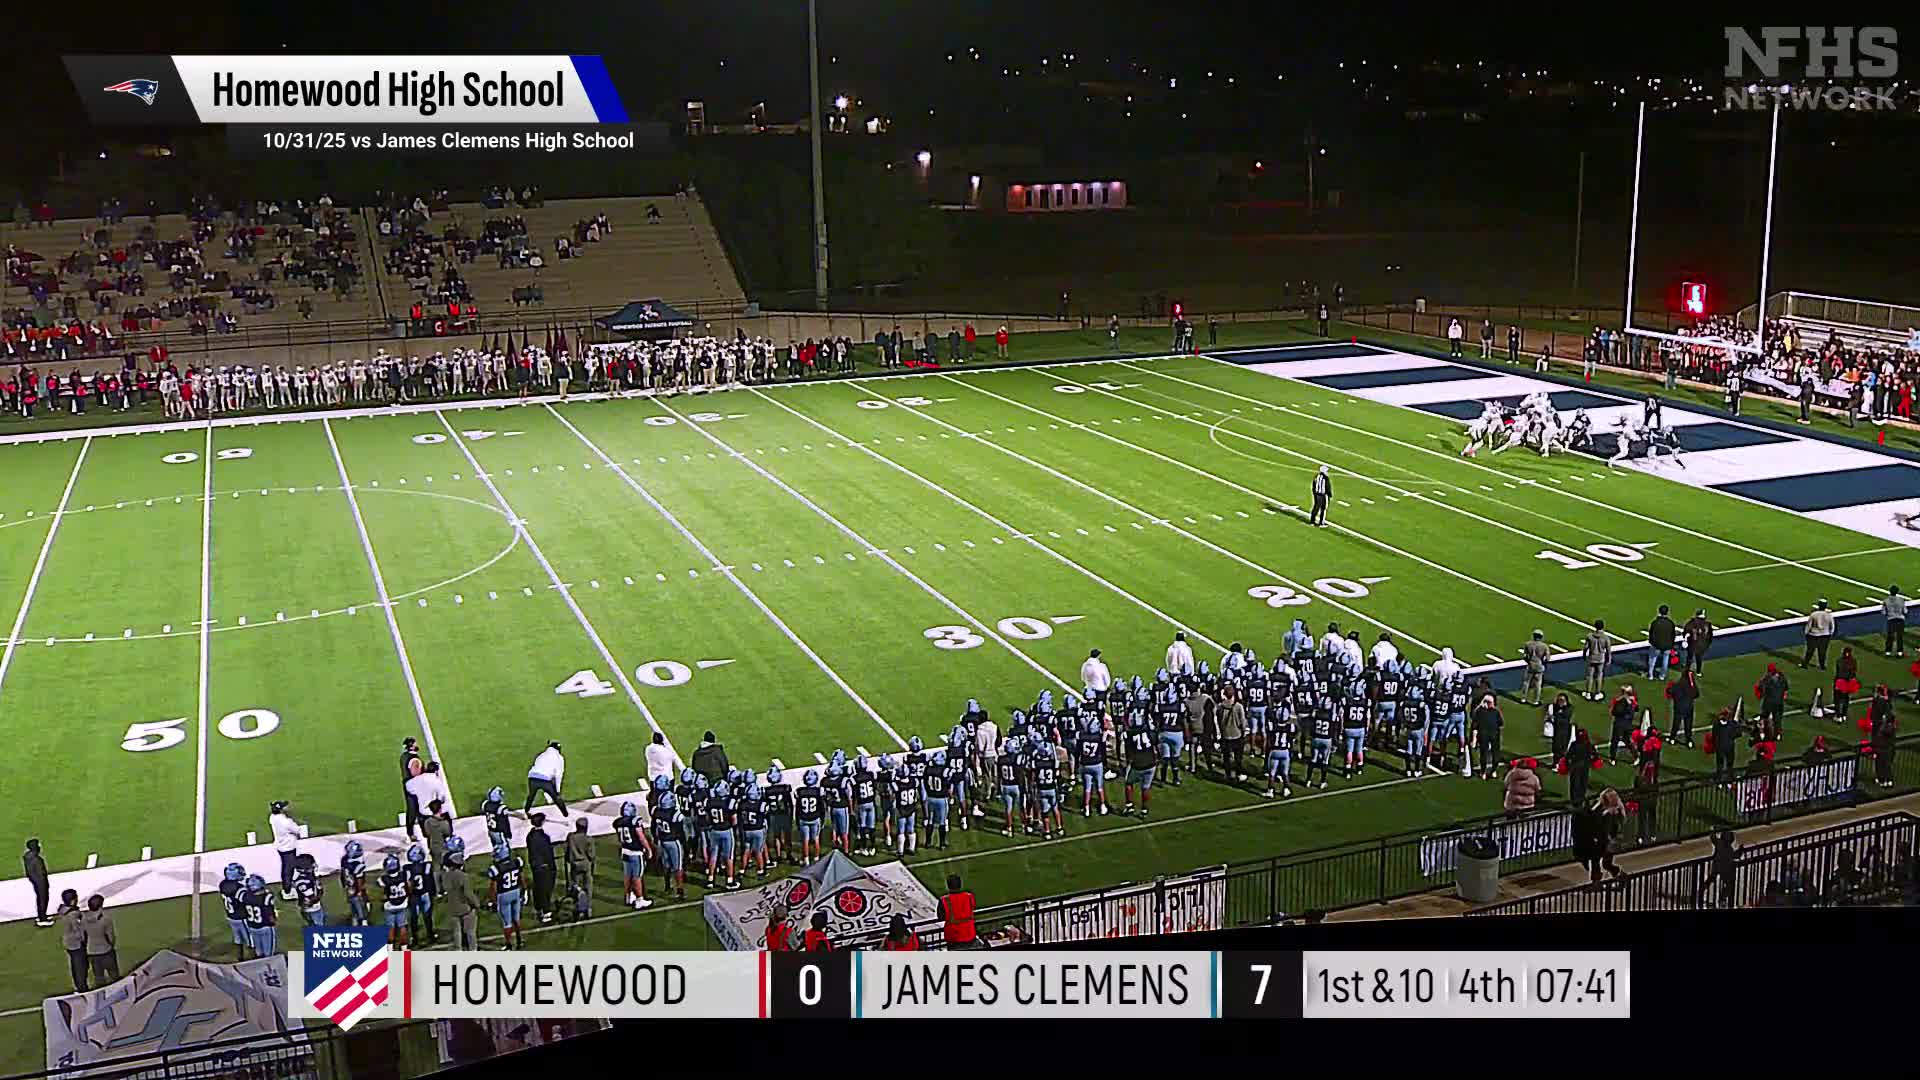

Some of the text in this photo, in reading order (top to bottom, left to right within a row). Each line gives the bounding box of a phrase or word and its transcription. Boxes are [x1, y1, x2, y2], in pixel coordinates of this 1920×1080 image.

[1249, 688, 1264, 702] 99
[1163, 712, 1178, 727] 77
[801, 797, 817, 814] 92
[710, 808, 725, 824] 91
[502, 869, 520, 889] 35
[245, 905, 263, 924] 93
